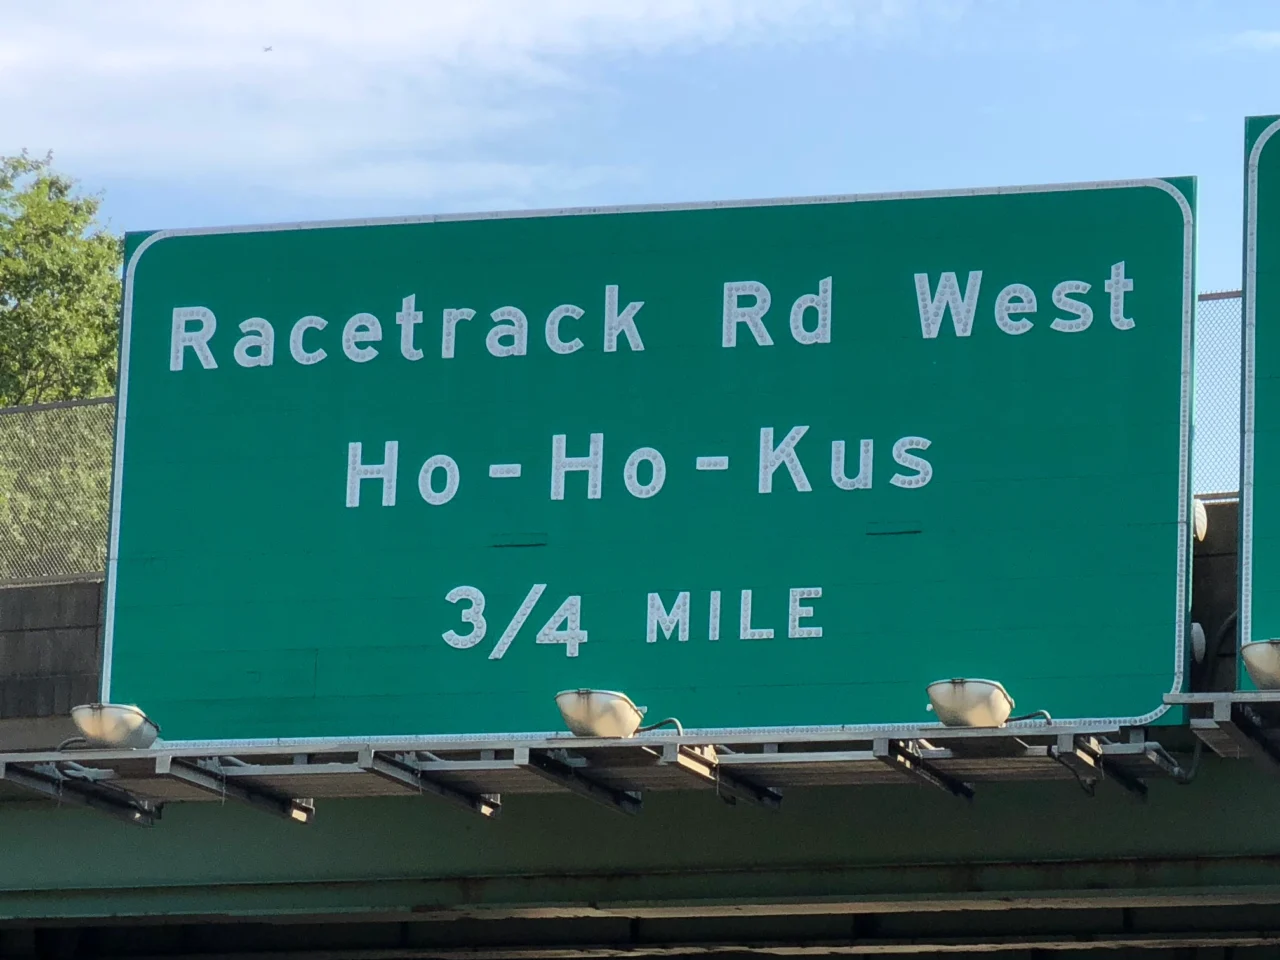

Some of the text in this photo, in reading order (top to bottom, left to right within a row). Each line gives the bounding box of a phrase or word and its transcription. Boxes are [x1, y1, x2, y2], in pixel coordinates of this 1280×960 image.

[168, 260, 1137, 373] Racetrack Rd West
[344, 425, 934, 508] Ho-Ho-Kus
[440, 583, 824, 661] 3/4 MILE
